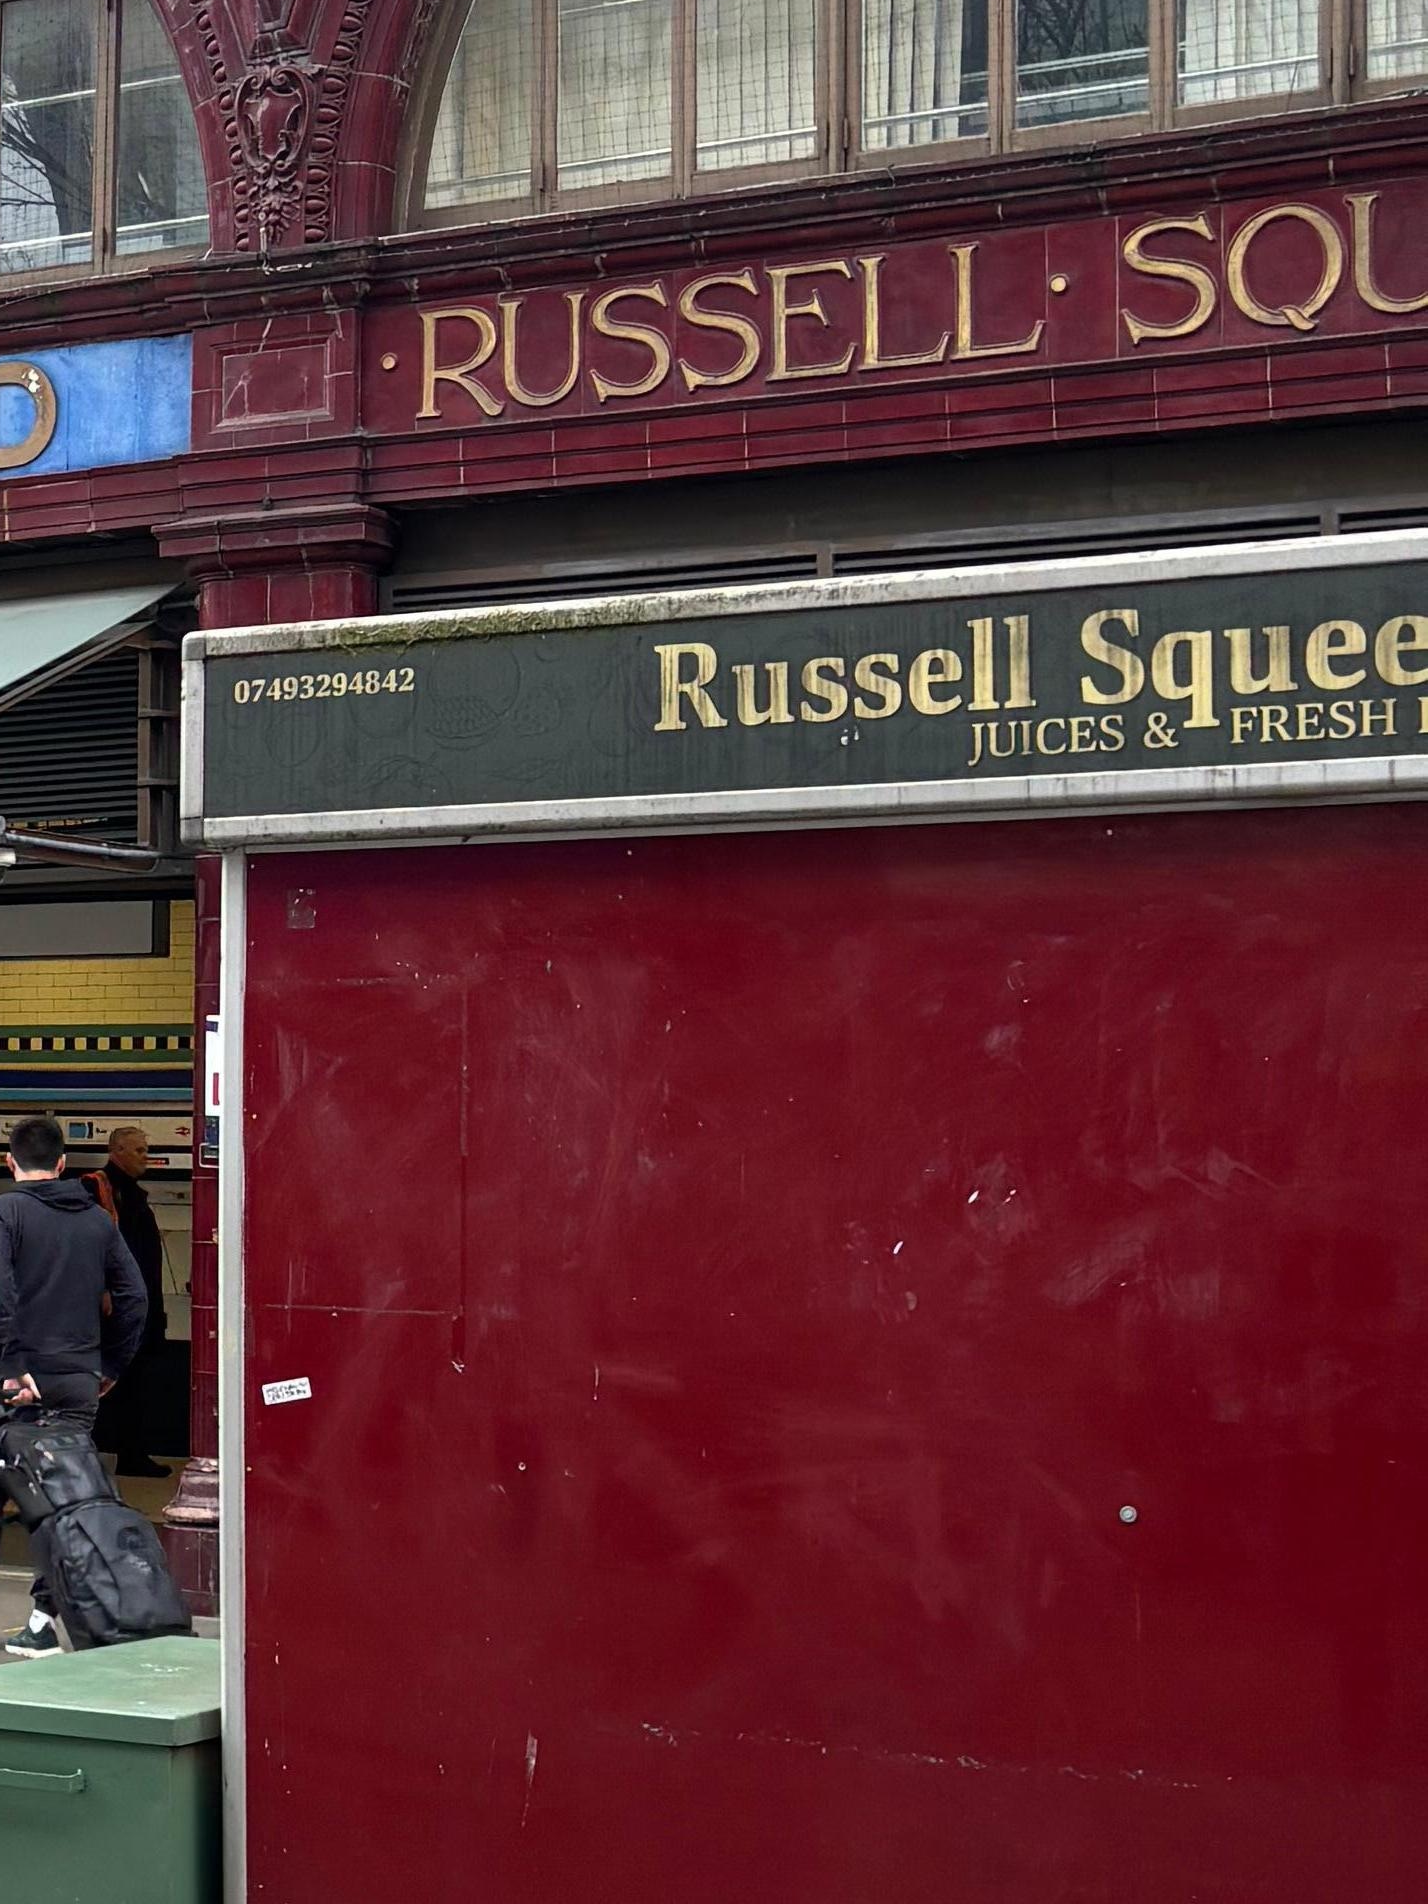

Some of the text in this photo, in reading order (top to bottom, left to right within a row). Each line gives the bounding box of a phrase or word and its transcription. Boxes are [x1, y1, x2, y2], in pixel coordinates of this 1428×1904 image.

[415, 241, 1046, 419] RUSSELL
[233, 667, 416, 704] 07493294842
[653, 607, 1428, 732] Russell Squee
[967, 714, 1126, 767] JUICES
[1143, 711, 1179, 749] &
[1230, 697, 1397, 744] FRESH
